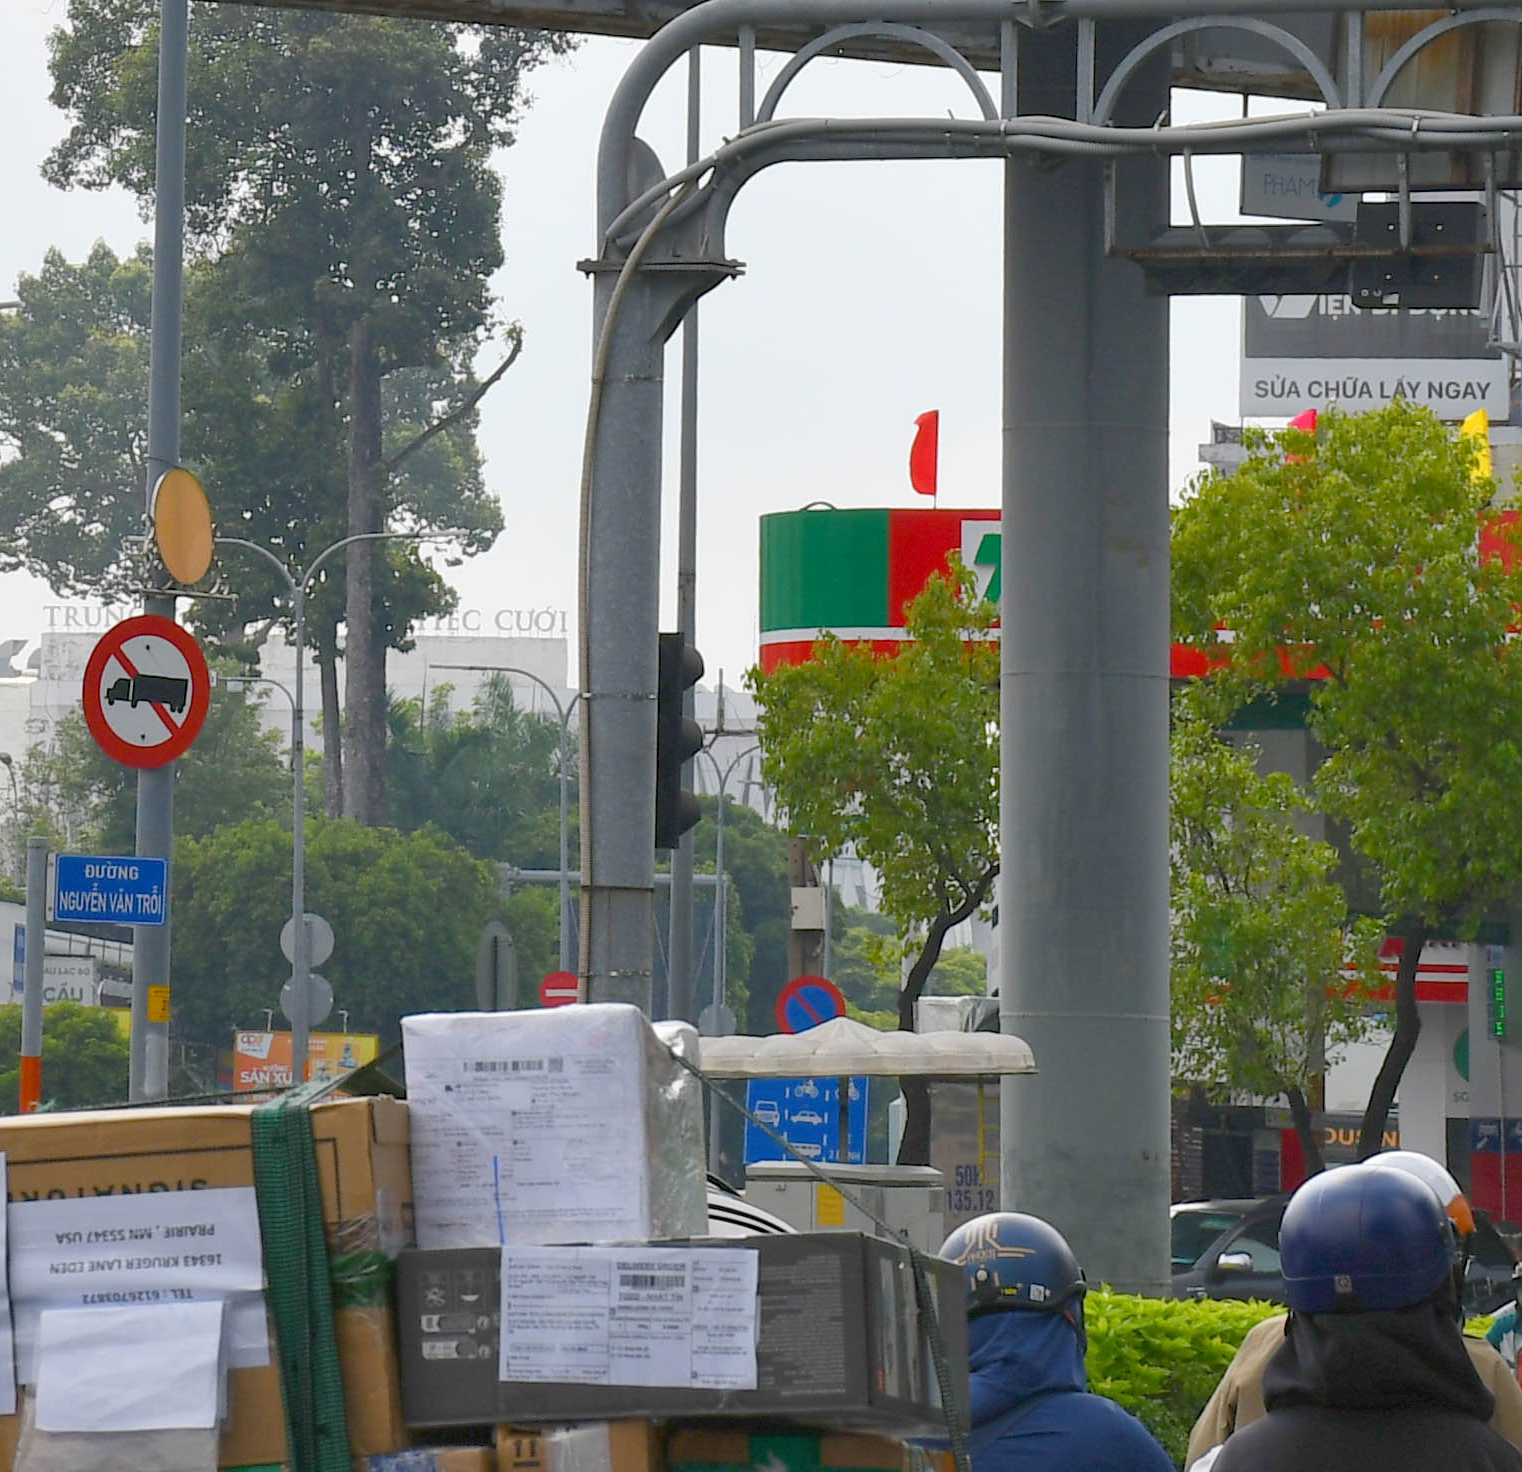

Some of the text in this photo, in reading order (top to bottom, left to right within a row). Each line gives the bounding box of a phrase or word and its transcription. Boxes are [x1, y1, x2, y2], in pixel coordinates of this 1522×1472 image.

[1254, 373, 1491, 400] SỬA CHỮA LẤY NGAY
[84, 861, 139, 880] ĐƯỜNG
[59, 882, 161, 915] NGUYỄN VĂN TRỖI
